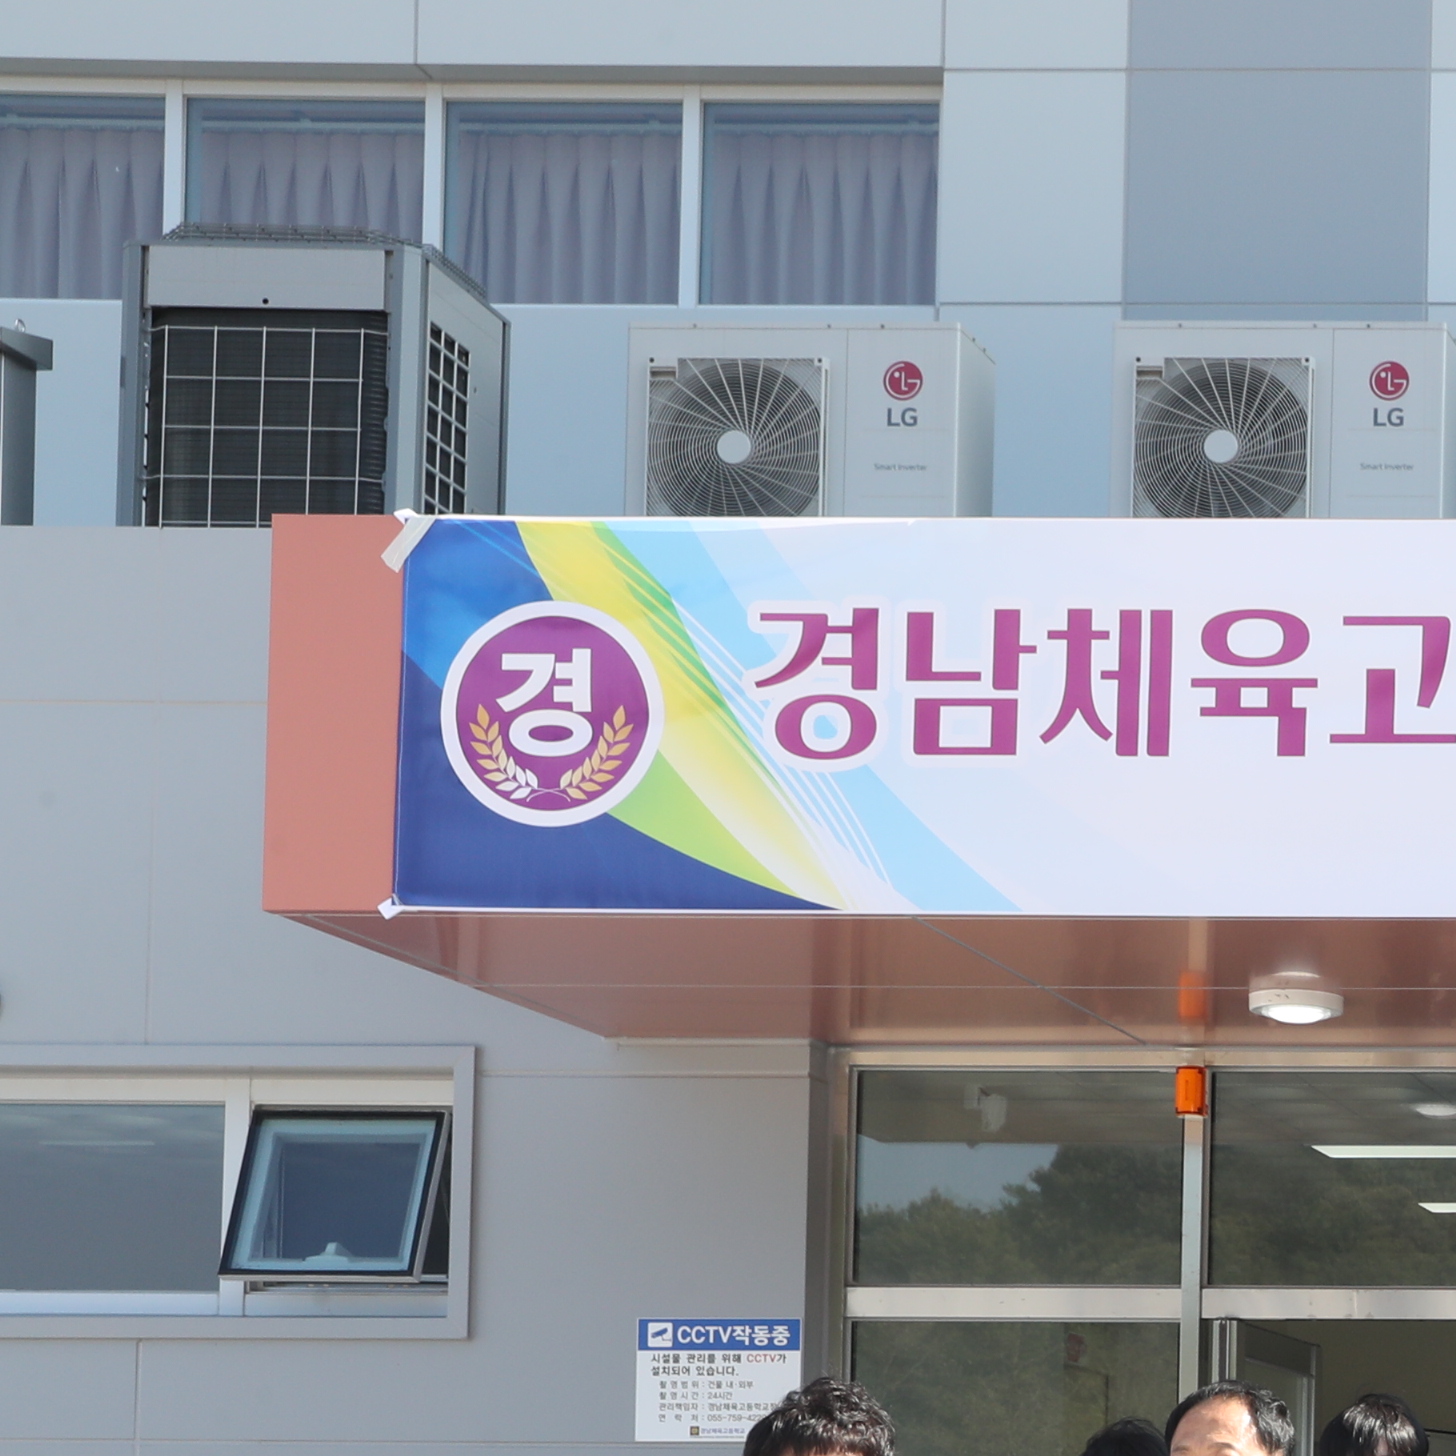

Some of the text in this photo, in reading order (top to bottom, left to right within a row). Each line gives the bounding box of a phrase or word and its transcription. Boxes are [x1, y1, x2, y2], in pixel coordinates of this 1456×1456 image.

[887, 408, 918, 427] LG
[1373, 408, 1404, 427] LG
[496, 647, 594, 758] 경
[677, 1325, 791, 1346] CCTV작동중
[651, 1353, 787, 1364] 시설물 관리를 위해 CCTV가
[651, 1366, 739, 1377] 설치되어 있습니다.
[708, 1381, 723, 1390] 건물
[707, 1391, 733, 1400] 24시간
